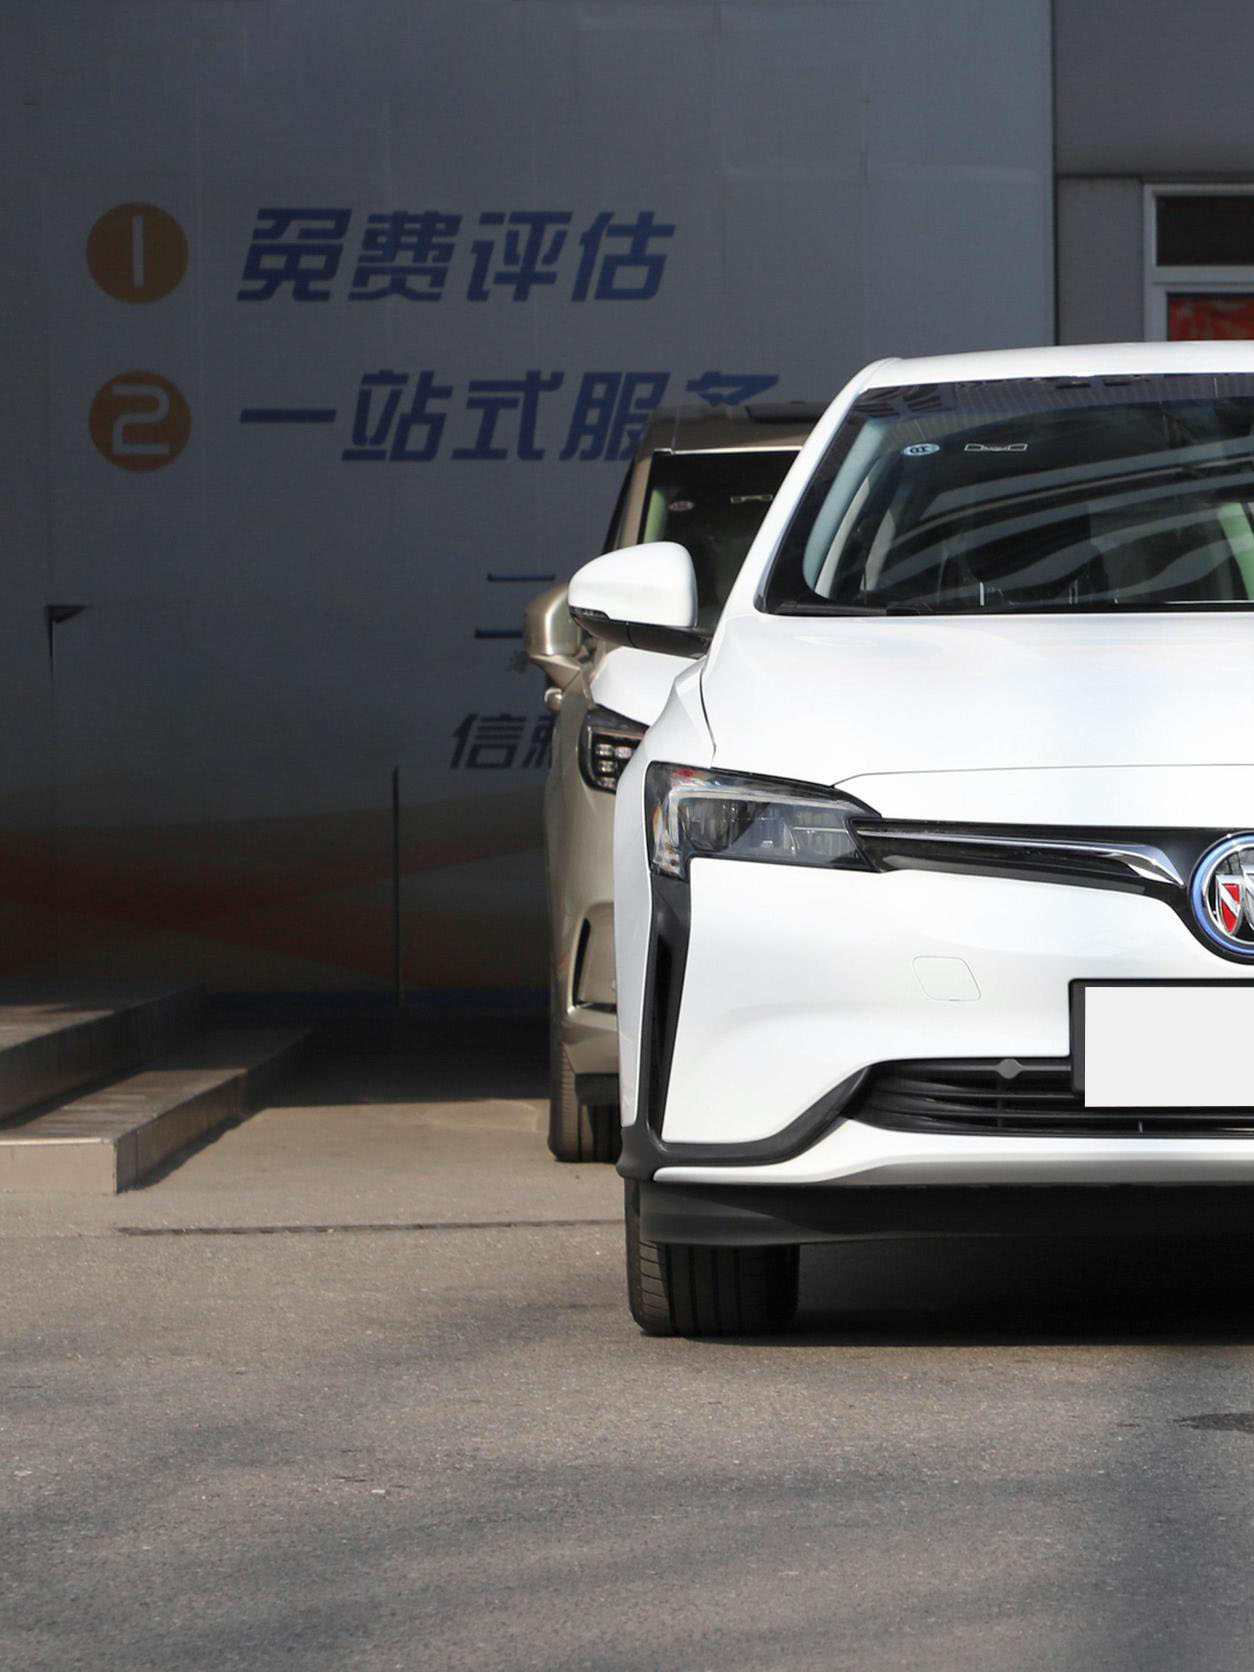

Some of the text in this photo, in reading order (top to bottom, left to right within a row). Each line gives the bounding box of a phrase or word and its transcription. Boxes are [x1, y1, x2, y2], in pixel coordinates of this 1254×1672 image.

[237, 207, 677, 303] 免费评估
[111, 383, 170, 455] 2
